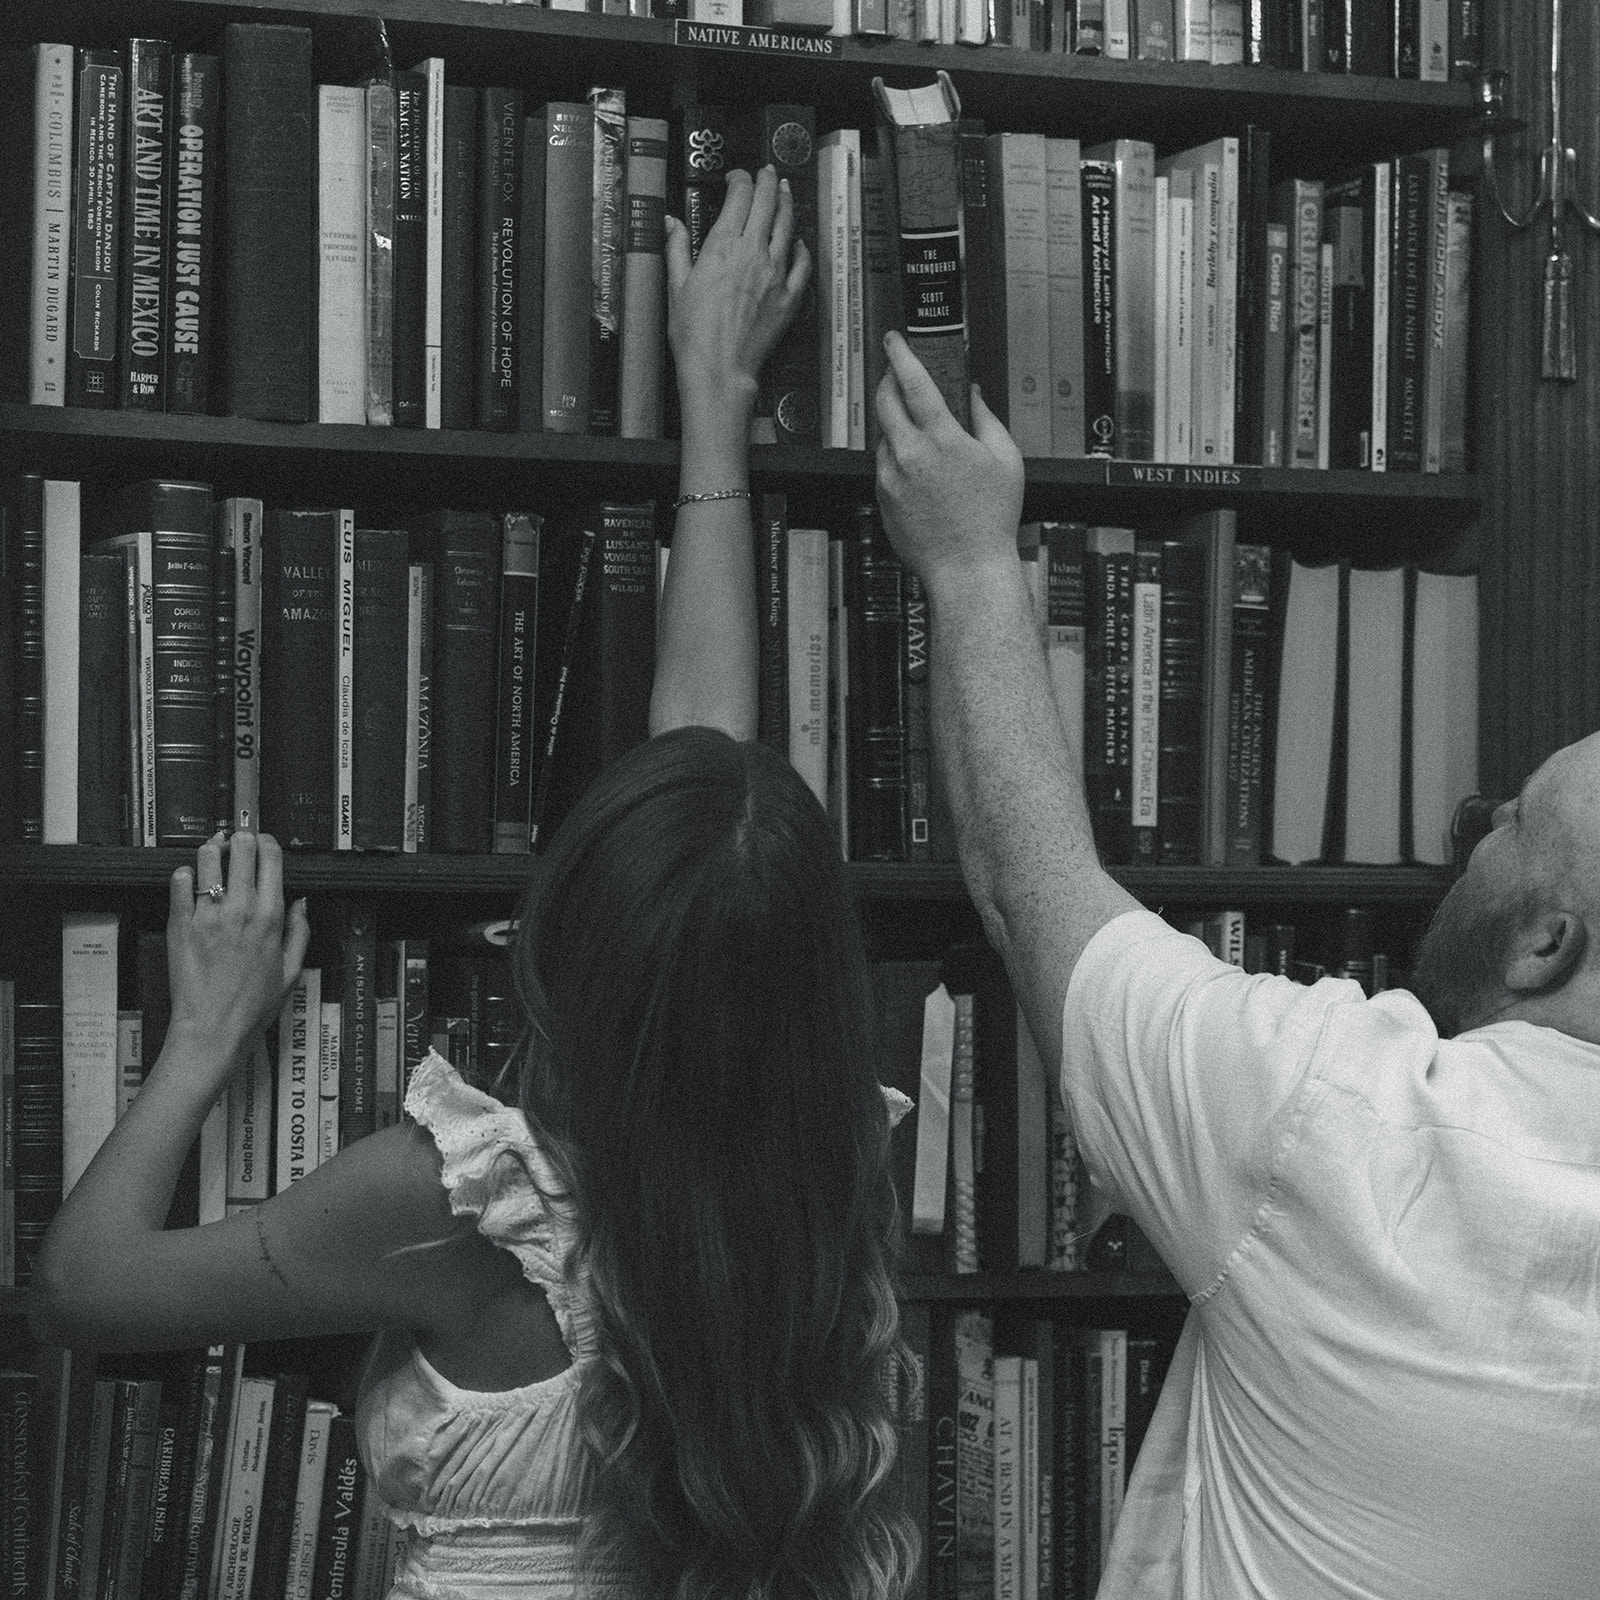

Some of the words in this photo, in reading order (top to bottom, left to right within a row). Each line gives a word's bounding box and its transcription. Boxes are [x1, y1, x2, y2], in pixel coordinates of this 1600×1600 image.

[687, 26, 740, 46] NATIVE
[747, 33, 834, 54] AMERICANS
[107, 74, 117, 100] THE
[106, 103, 117, 141] HAND
[134, 87, 164, 133] ART
[399, 90, 411, 149] MEXICAN
[47, 110, 63, 200] COLUMBUS
[502, 101, 515, 168] VICENTE
[134, 133, 164, 180] AND
[399, 152, 411, 200] NATION
[104, 163, 115, 219] CAPTAIN
[176, 125, 205, 237] OPERATION
[502, 172, 514, 204] FOX
[1102, 196, 1110, 207] A
[132, 183, 162, 240] TIME
[1092, 194, 1101, 214] Art
[103, 223, 113, 274] DANJOU
[1092, 217, 1101, 243] and
[1101, 210, 1110, 256] History
[46, 222, 62, 281] MARTIN
[131, 244, 162, 269] IN
[175, 240, 202, 287] JUST
[500, 217, 514, 317] REVOLUTION
[1102, 258, 1110, 271] of
[94, 283, 102, 309] COLIN
[921, 291, 944, 304] SCOTT
[1092, 244, 1102, 325] Architecture
[45, 286, 60, 343] DUGARD
[93, 310, 101, 352] RICKARDS
[129, 271, 161, 358] MEXICO
[173, 290, 201, 356] CAUSE
[500, 320, 513, 343] OF
[917, 305, 950, 318] WALLACE
[499, 346, 513, 389] HOPE
[1132, 466, 1175, 483] WEST
[1183, 468, 1242, 486] INDIES
[242, 511, 253, 544] Simon
[342, 519, 353, 565] LUIS
[341, 578, 352, 658] MIGUEL
[513, 610, 525, 634] THE
[906, 600, 926, 672] MAYA
[512, 637, 524, 662] ART
[235, 628, 256, 729] Waypoint
[511, 664, 523, 682] OF
[807, 633, 822, 712] memorias
[341, 675, 351, 719] Claudia
[509, 684, 522, 729] NORTH
[236, 733, 255, 761] 90
[341, 721, 350, 737] de
[800, 719, 821, 746] mis
[340, 739, 350, 770] Icaza
[508, 730, 521, 788] AMERICA
[340, 794, 350, 837] EDAMEX
[355, 953, 365, 972] AN
[291, 983, 308, 1015] THE
[355, 974, 365, 1021] ISLAND
[291, 1016, 307, 1051] NEW
[329, 1033, 339, 1072] MARIO
[354, 1022, 364, 1074] CALLED
[291, 1053, 307, 1087] KEY
[290, 1088, 306, 1111] TO
[353, 1076, 364, 1115] HOME
[241, 1126, 254, 1150] Rica
[290, 1112, 306, 1163] COSTA
[240, 1150, 255, 1185] Costa
[11, 1390, 33, 1483] Crossroads
[306, 1429, 321, 1466] Davis
[1000, 1416, 1012, 1438] AT
[156, 1426, 176, 1503] CARIBBEAN
[11, 1485, 31, 1504] of
[332, 1457, 357, 1520] Valdés
[935, 1415, 956, 1559] CHAVIN
[152, 1505, 168, 1544] ISLES
[241, 1504, 254, 1545] MEXICO
[1000, 1510, 1012, 1530] IN
[11, 1504, 31, 1597] Continents
[226, 1516, 241, 1590] ARCHEOLOGIE
[239, 1547, 250, 1562] DE
[325, 1526, 350, 1600] enínsula
